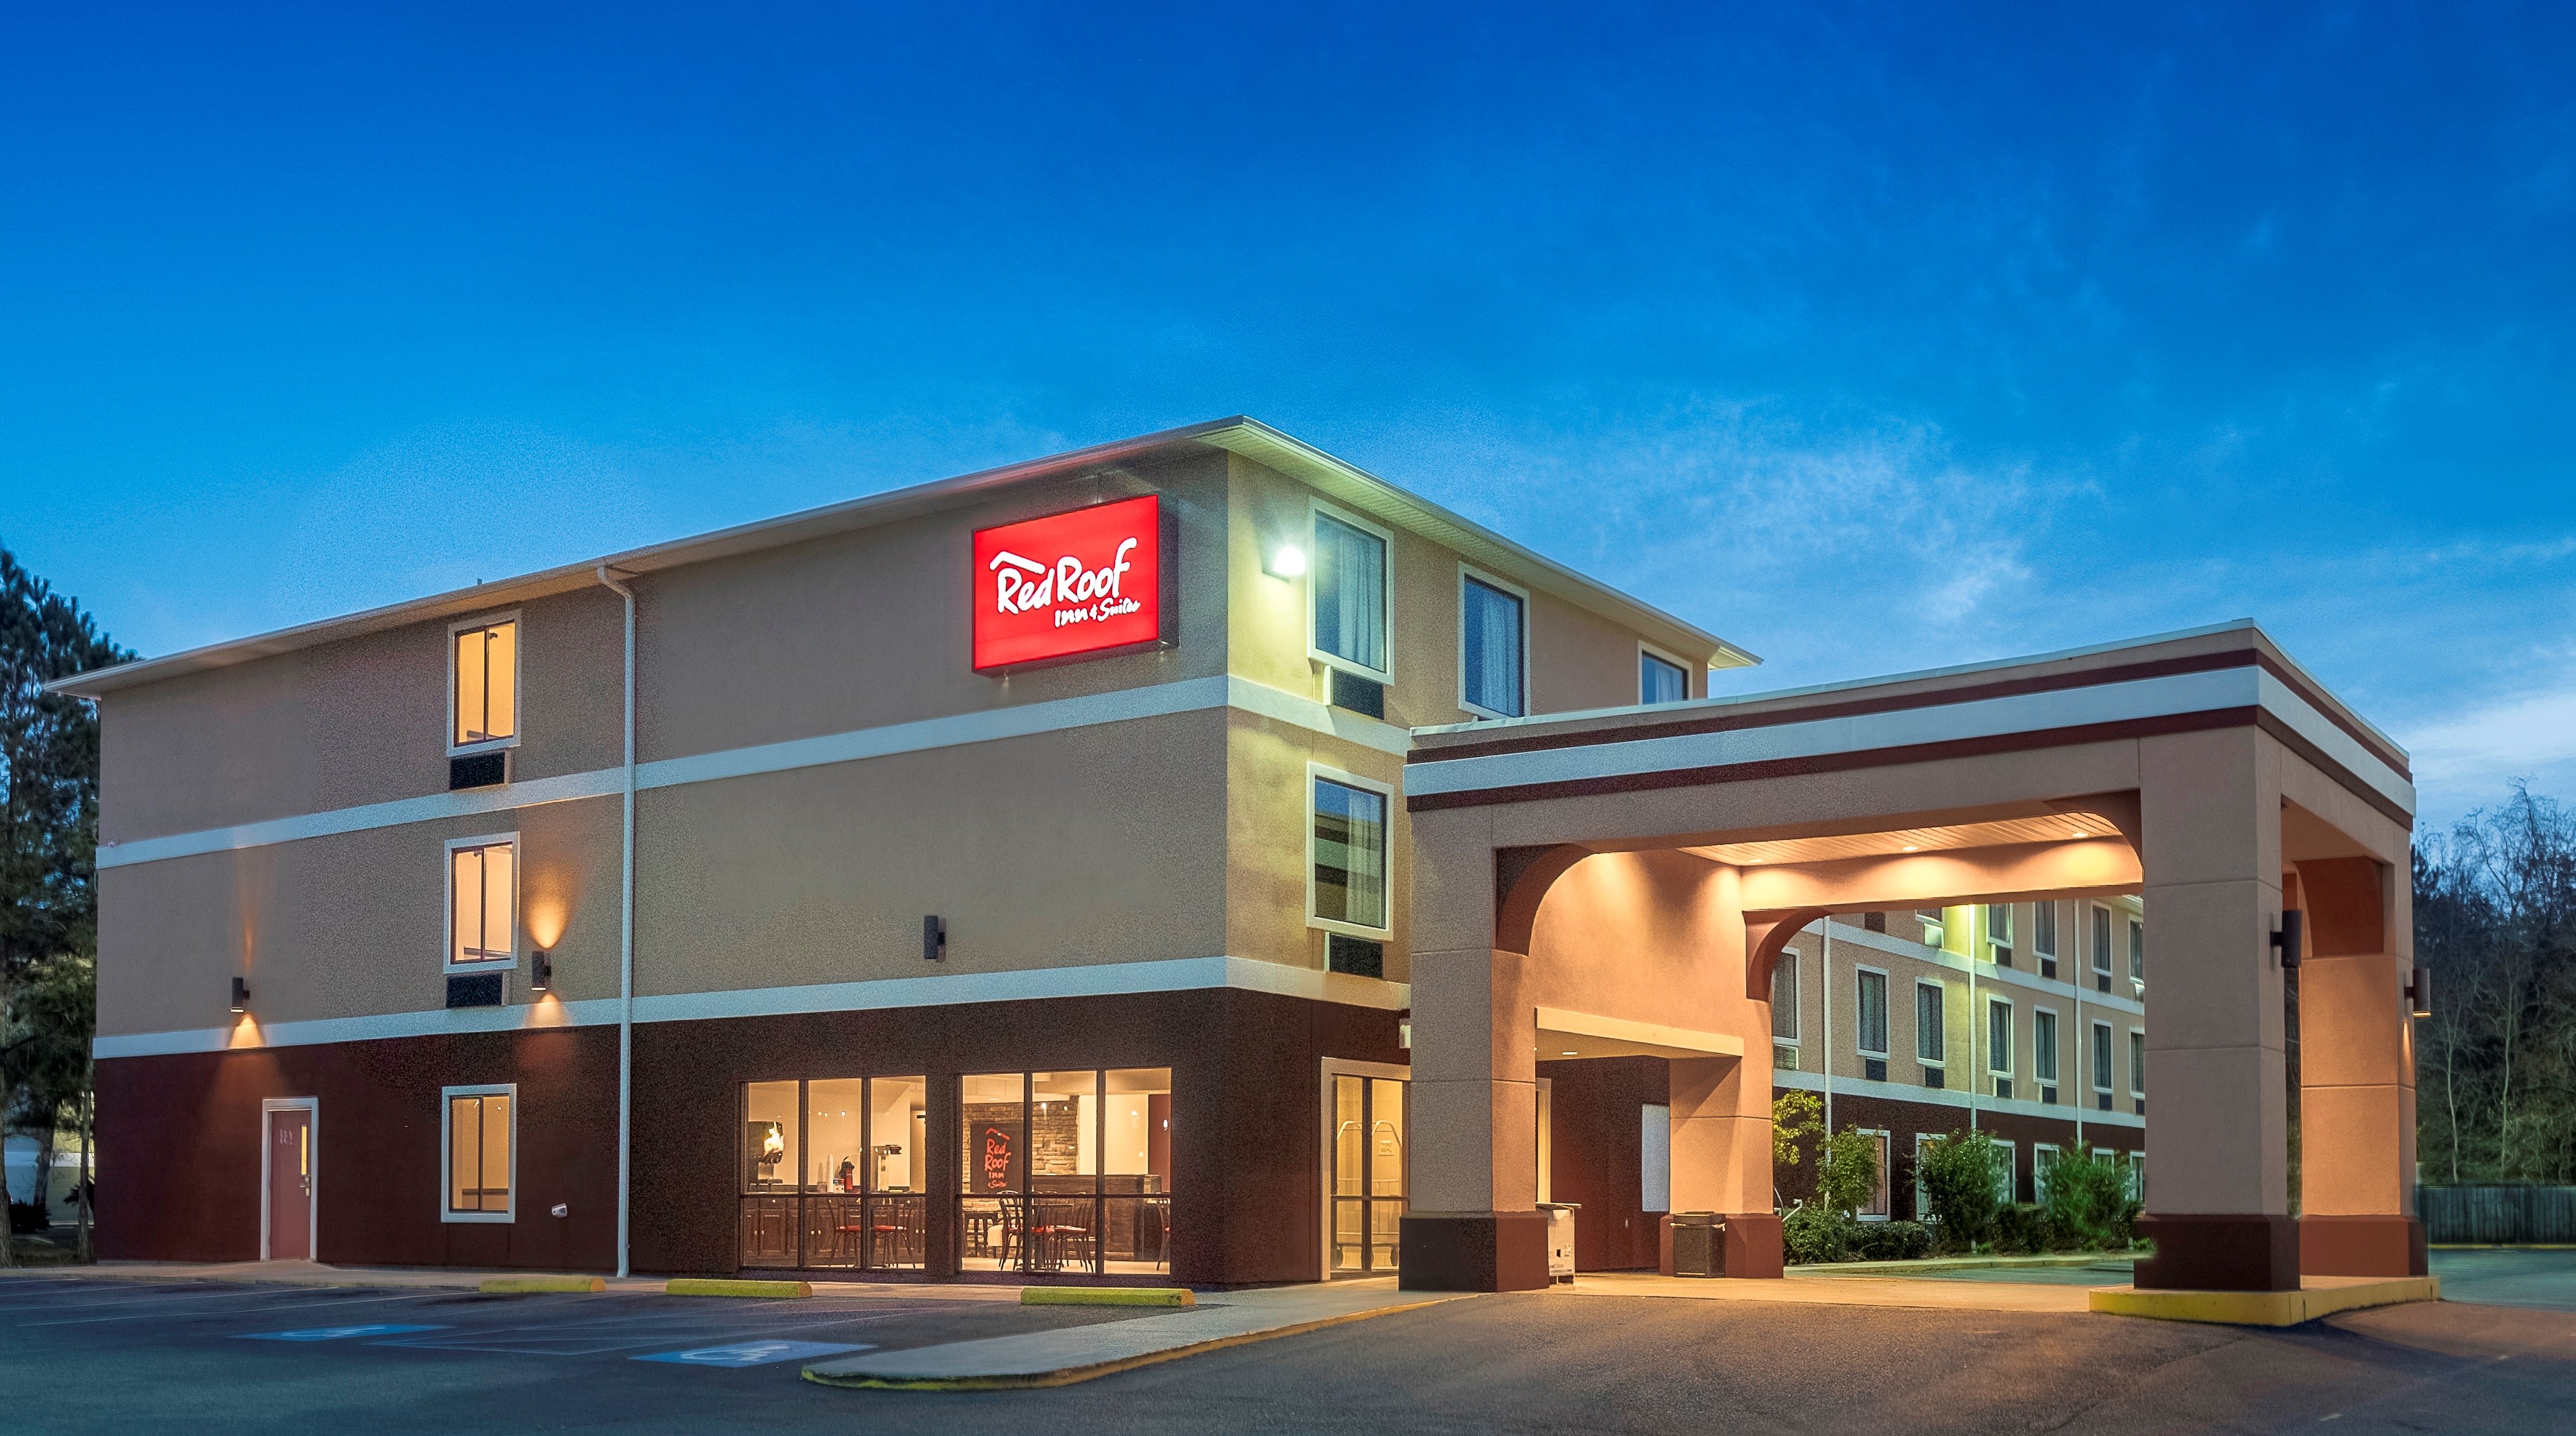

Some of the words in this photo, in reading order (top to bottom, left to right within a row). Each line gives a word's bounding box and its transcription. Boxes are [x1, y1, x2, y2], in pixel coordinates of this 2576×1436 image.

[997, 568, 1055, 615] Red
[1057, 537, 1137, 603] Roof
[1055, 608, 1088, 628] Inn
[1097, 597, 1141, 622] Suites
[986, 1138, 1006, 1155] Red
[984, 1151, 1011, 1172] Roof
